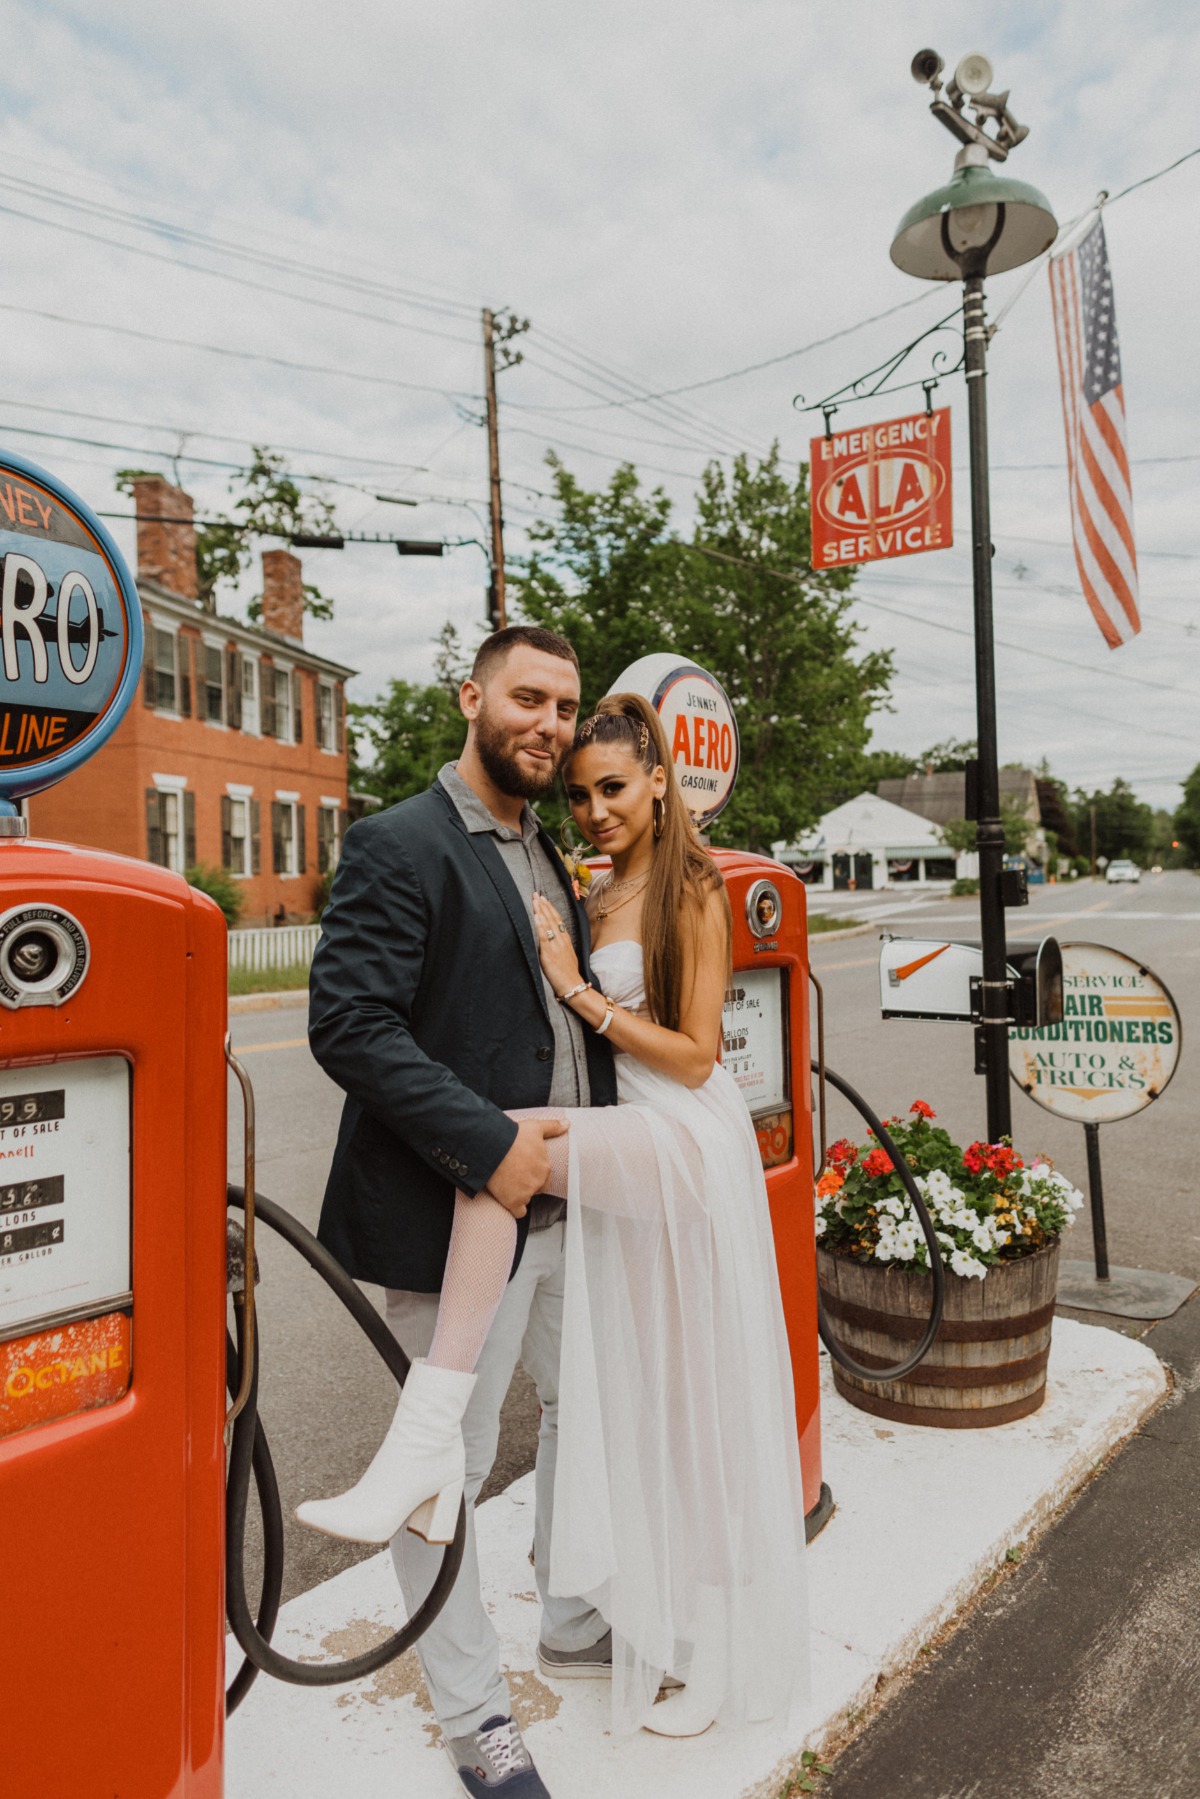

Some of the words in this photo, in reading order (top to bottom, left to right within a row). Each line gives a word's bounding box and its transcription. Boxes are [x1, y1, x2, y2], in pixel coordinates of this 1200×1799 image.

[820, 414, 941, 460] EMERGENCY
[837, 462, 926, 520] ALA
[822, 523, 942, 563] SERVICE
[686, 692, 717, 713] JENNEY
[0, 712, 67, 756] LINE
[672, 713, 732, 773] AERO
[681, 774, 718, 793] GASOLINE
[22, 910, 53, 921] BEFORE
[60, 918, 76, 932] AND
[72, 932, 85, 956] AFTER
[63, 957, 85, 993] DELIVERY
[1063, 975, 1145, 989] SERVICE
[1065, 994, 1104, 1016] AIR
[1030, 1052, 1106, 1069] AUTO
[1118, 1055, 1135, 1071] &
[1030, 1069, 1146, 1089] TRUCKS
[13, 1126, 26, 1138] OF
[33, 1121, 60, 1135] SALE
[0, 1211, 36, 1228] LONS
[19, 1247, 53, 1261] GALLON
[6, 1345, 123, 1398] OCTANE
